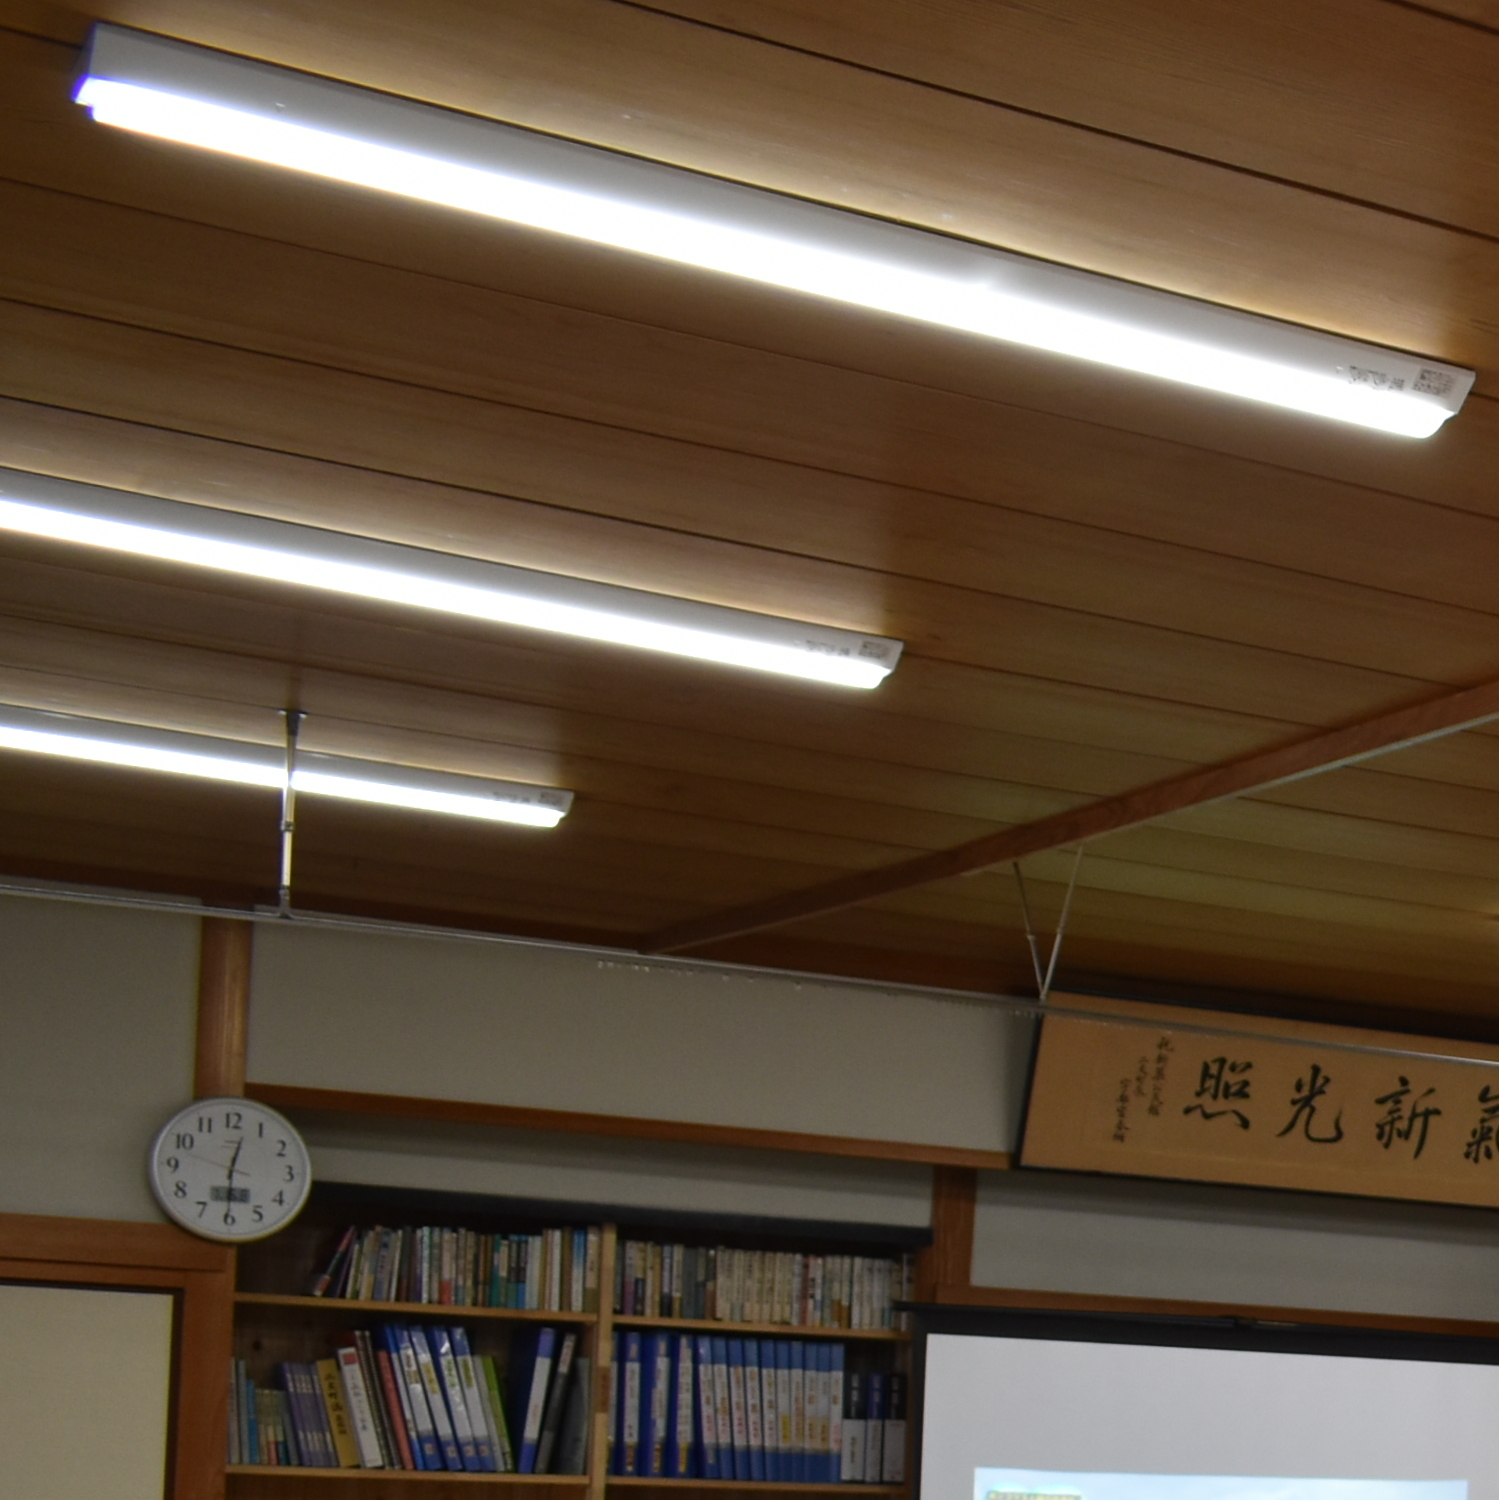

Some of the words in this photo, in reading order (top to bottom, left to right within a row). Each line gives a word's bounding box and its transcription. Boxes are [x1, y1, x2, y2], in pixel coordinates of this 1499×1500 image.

[197, 1117, 213, 1133] 11
[225, 1112, 242, 1129] 12
[257, 1122, 264, 1138] 1
[175, 1134, 194, 1150] 10
[276, 1140, 287, 1157] 2
[166, 1157, 179, 1173] 9
[283, 1165, 295, 1182] 3
[174, 1181, 187, 1199] 8
[272, 1190, 284, 1206] 4
[195, 1201, 207, 1218] 7
[252, 1206, 264, 1222] 5
[223, 1212, 236, 1226] 6
